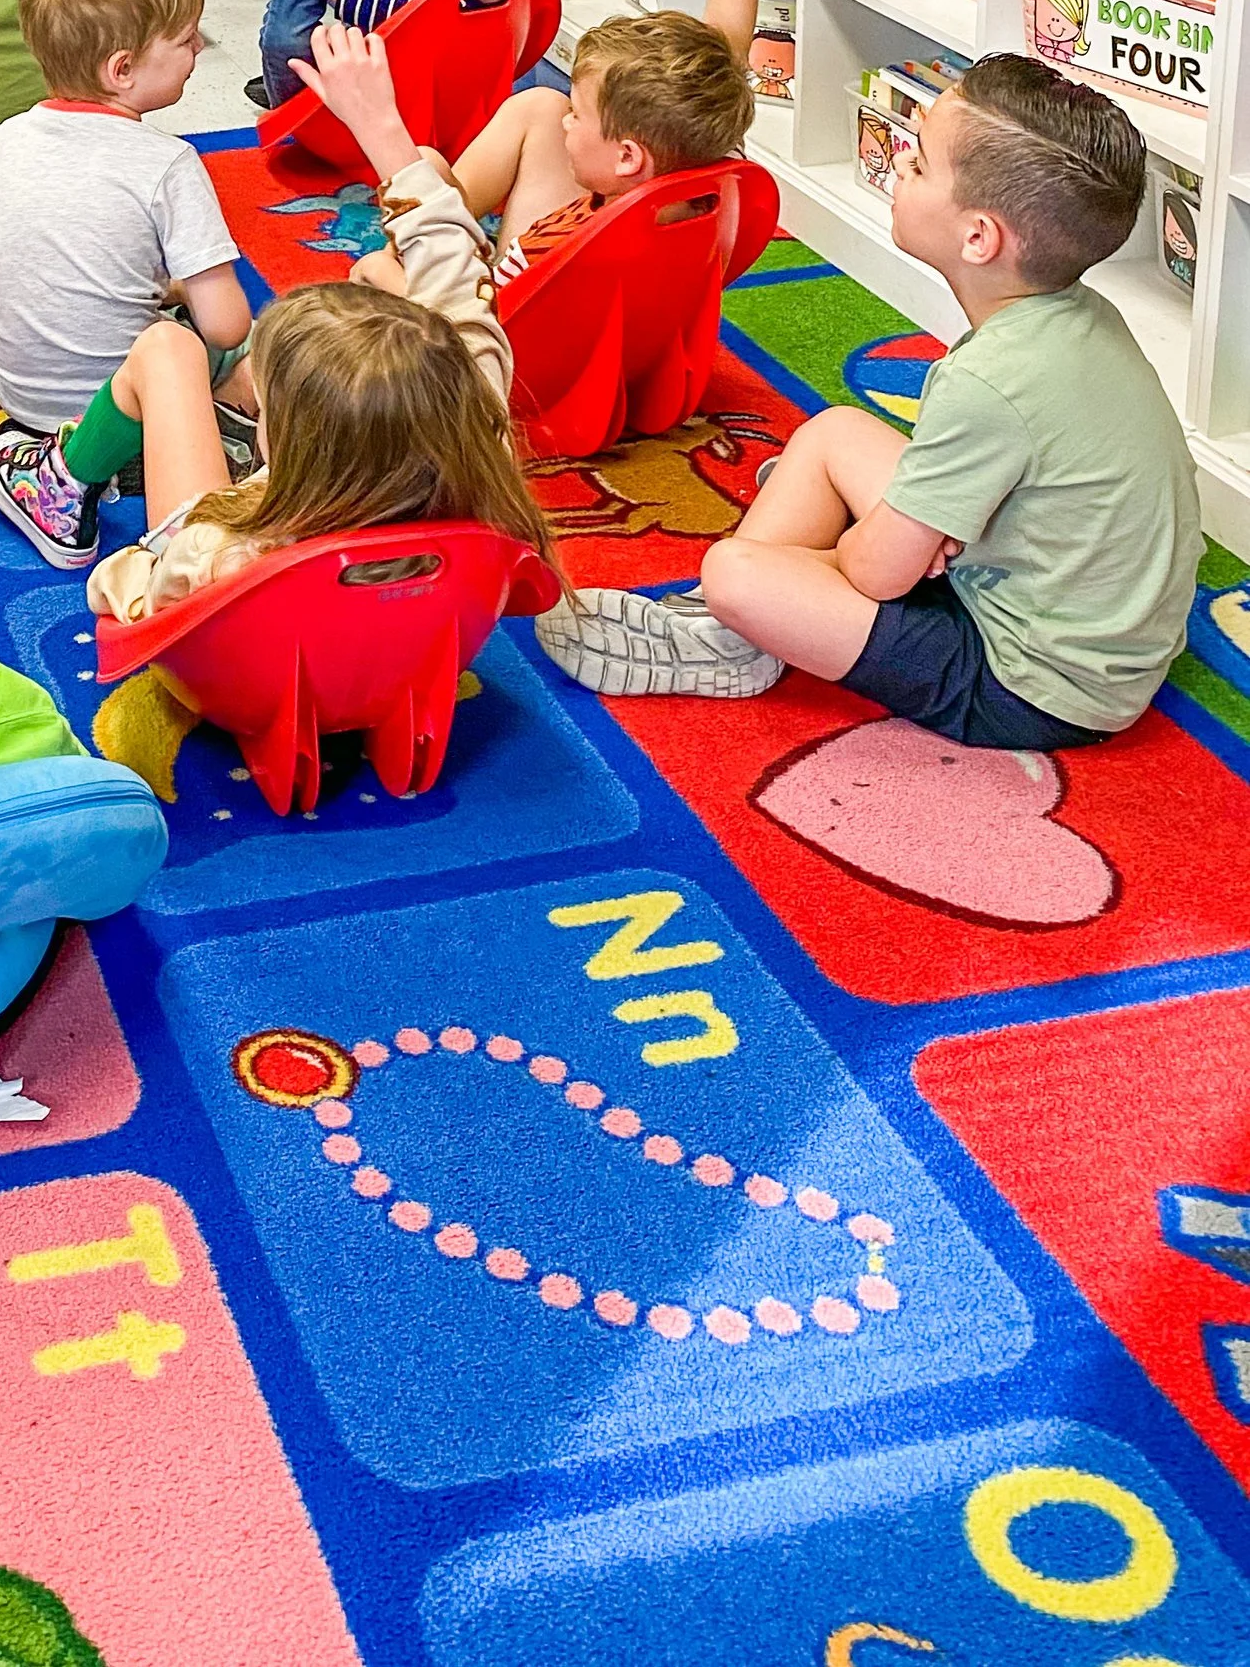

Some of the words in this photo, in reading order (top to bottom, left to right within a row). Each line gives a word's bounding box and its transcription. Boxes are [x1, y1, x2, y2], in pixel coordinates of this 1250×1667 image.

[1111, 34, 1206, 93] FOUR
[547, 890, 739, 1067] Nn
[7, 1202, 186, 1379] Tt
